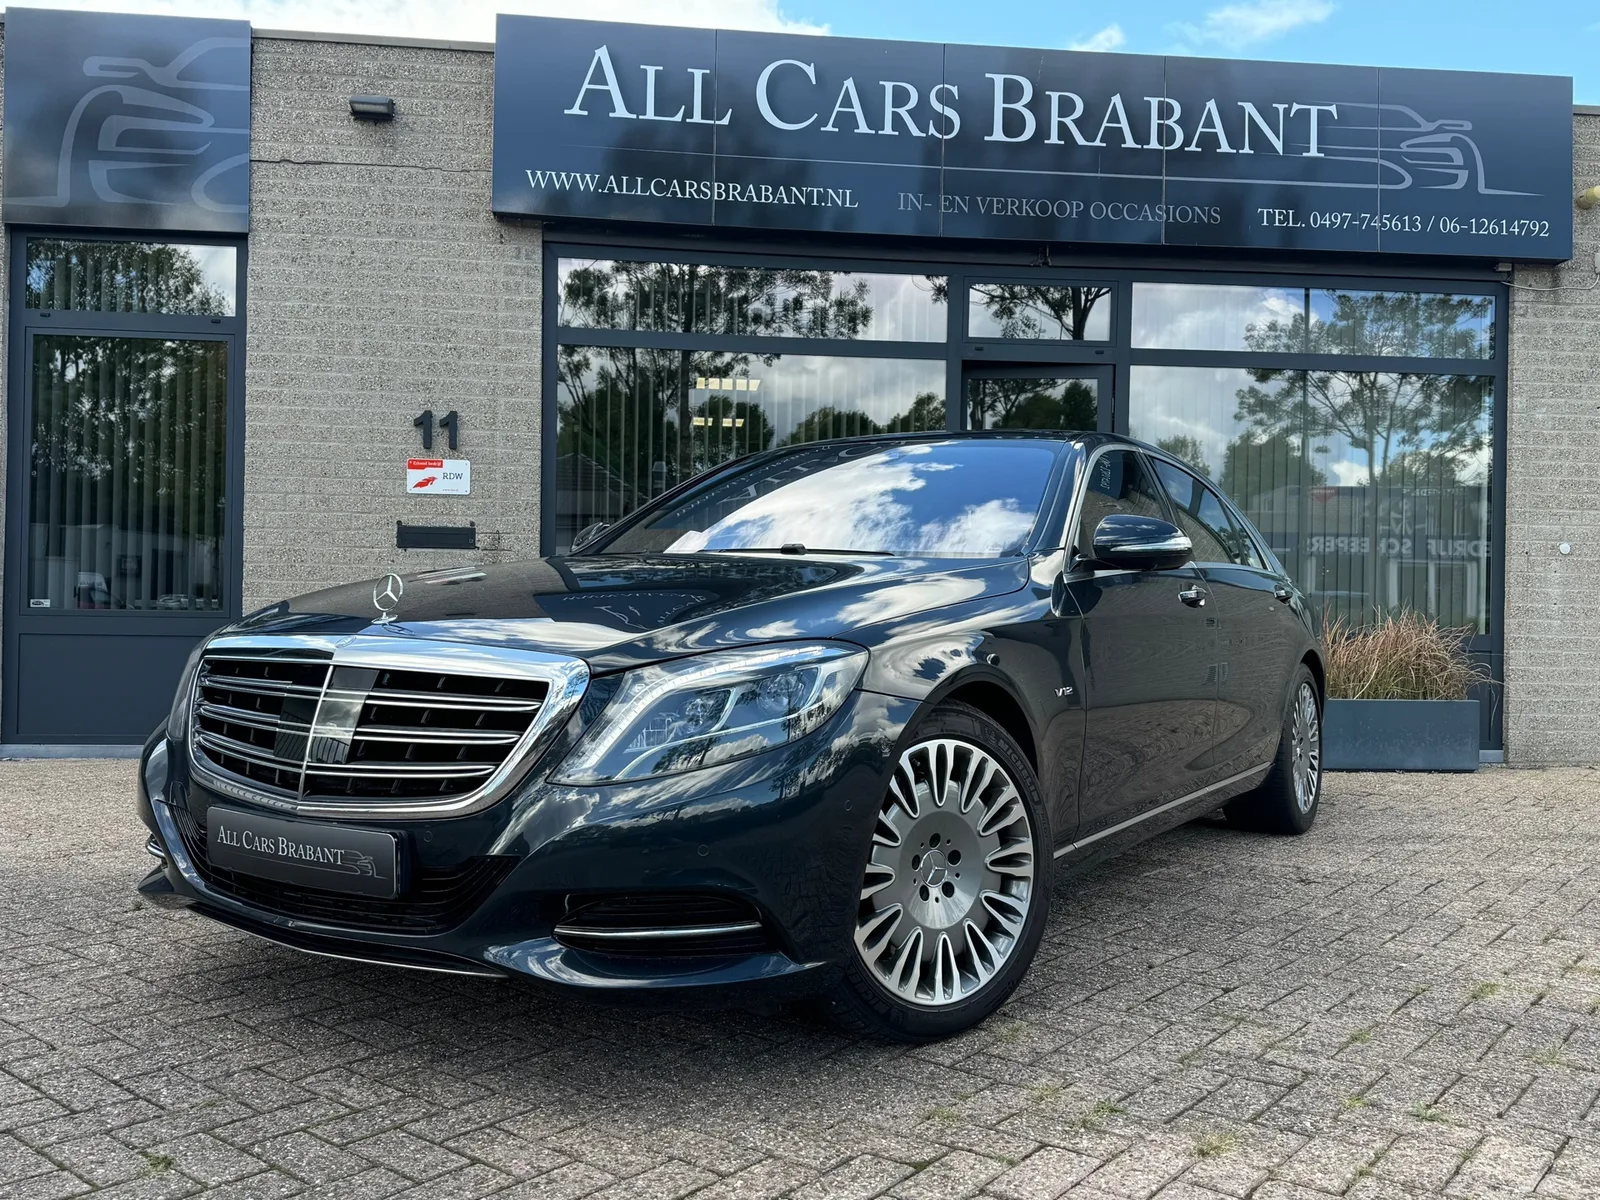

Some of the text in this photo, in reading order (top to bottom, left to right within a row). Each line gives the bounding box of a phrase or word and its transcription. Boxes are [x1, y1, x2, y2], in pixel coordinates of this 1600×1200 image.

[564, 45, 1337, 157] ALL CARS BRABANT
[525, 169, 858, 208] WWW.ALLCARSBRABANT.NL
[898, 192, 1221, 225] IN- EN VERKOOP OCCASIONS
[1257, 208, 1550, 237] TEL. 0497-745613 / 06-12614792
[414, 410, 458, 449] 11
[442, 472, 463, 480] RDW
[1054, 687, 1073, 697] V12
[997, 738, 1041, 805] MICHELIN
[217, 825, 345, 864] ALL CARS BRABANT
